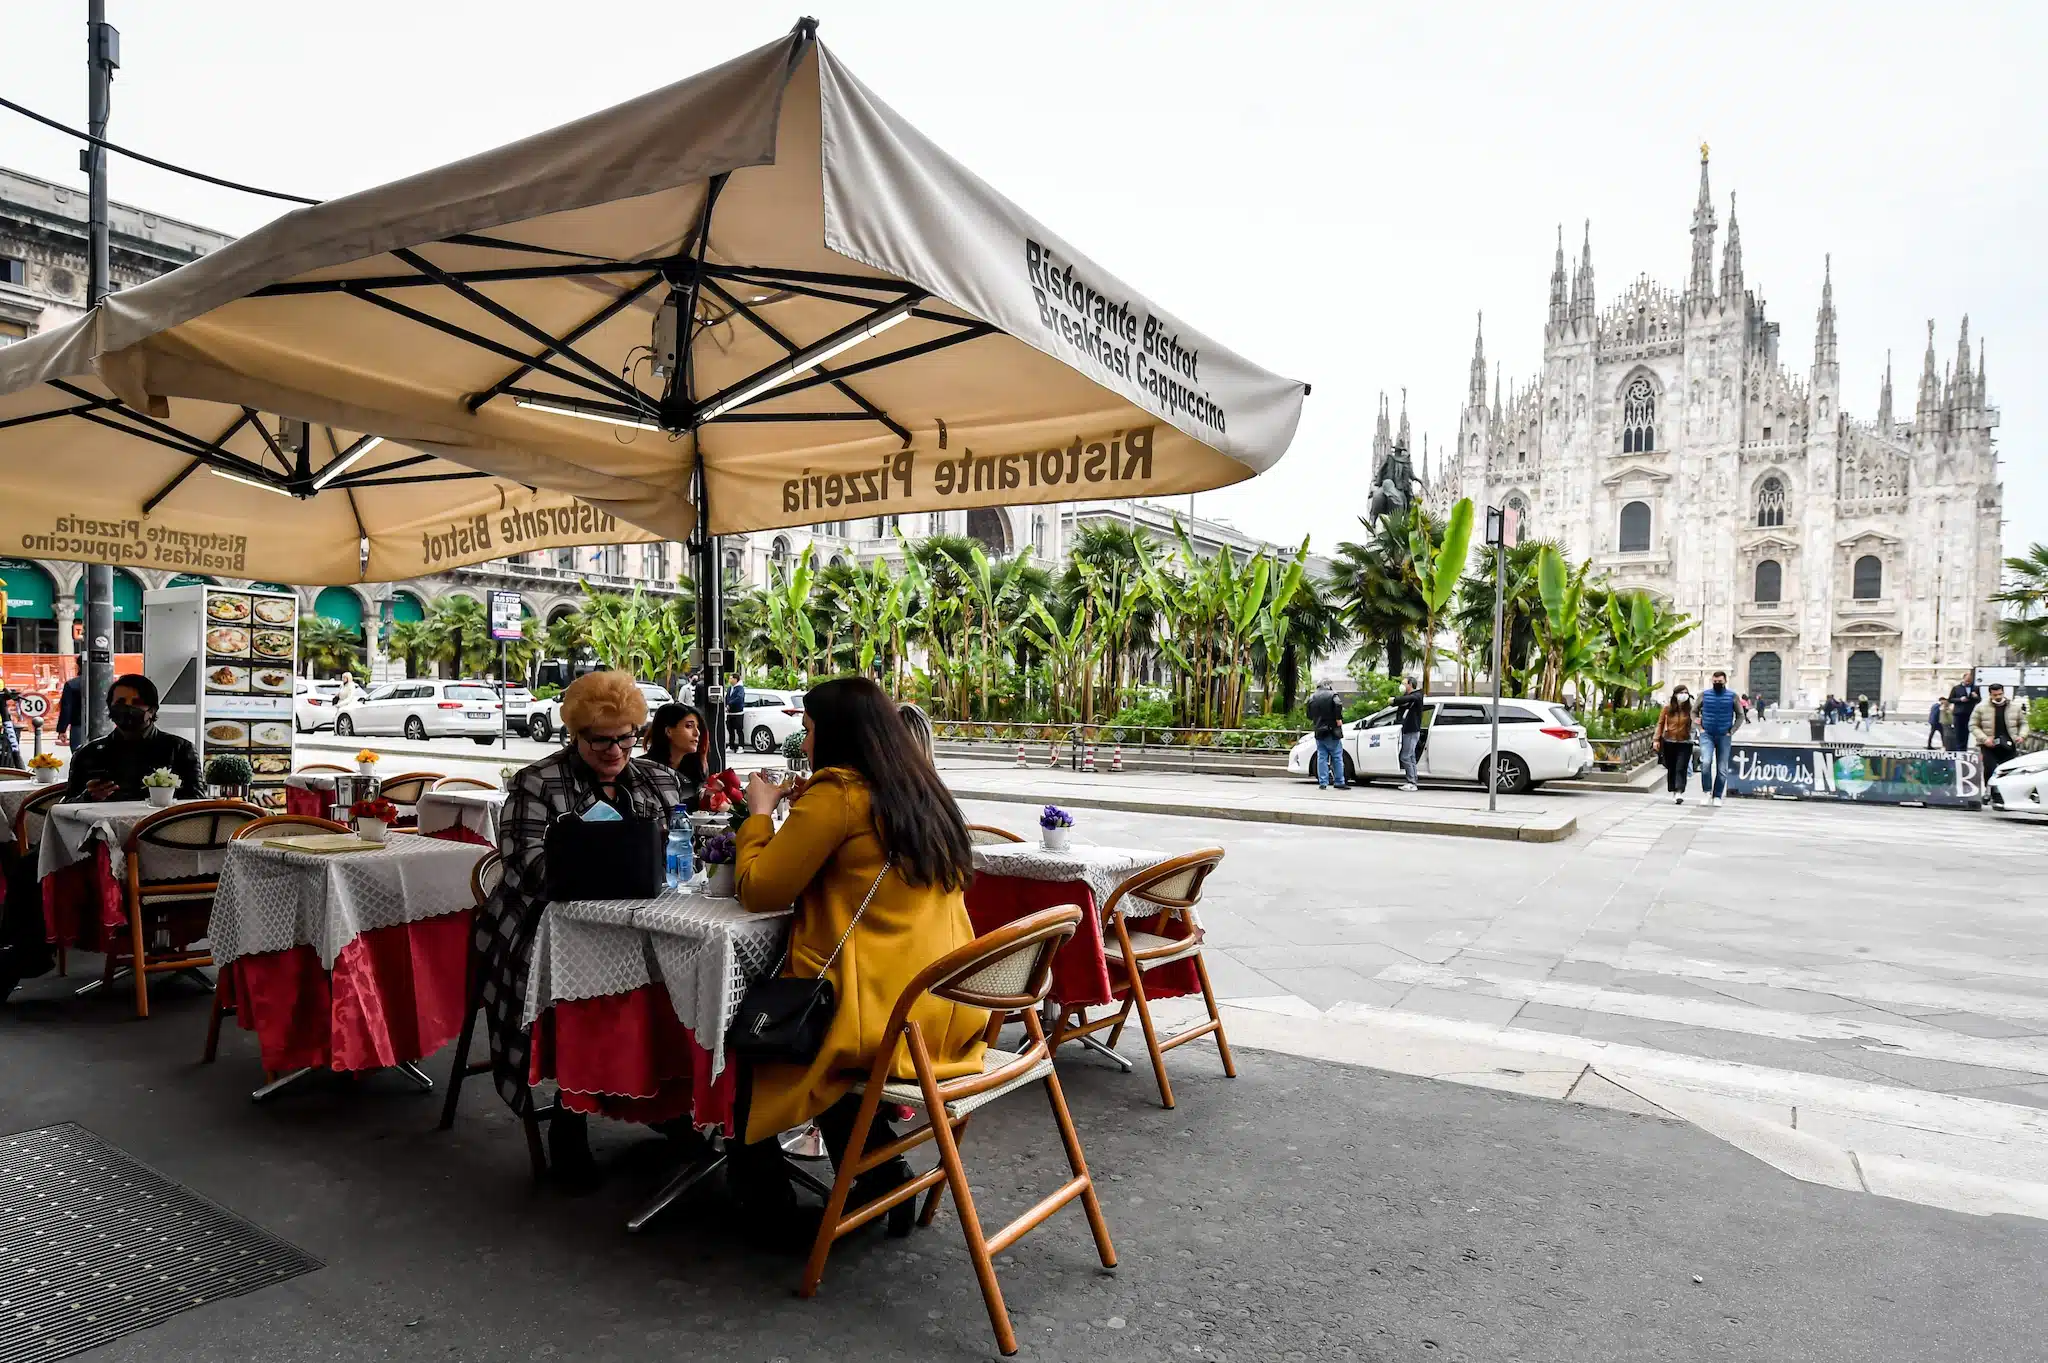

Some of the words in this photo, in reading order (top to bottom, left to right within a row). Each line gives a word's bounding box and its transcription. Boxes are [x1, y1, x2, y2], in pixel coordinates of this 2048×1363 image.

[1025, 238, 1137, 345] Ristorante
[1142, 313, 1199, 383] Bistrot
[1032, 285, 1132, 382] Breakfast
[1136, 351, 1226, 434] Cappuccino
[24, 699, 44, 713] 30
[1732, 750, 1792, 782] there
[1792, 756, 1813, 784] is
